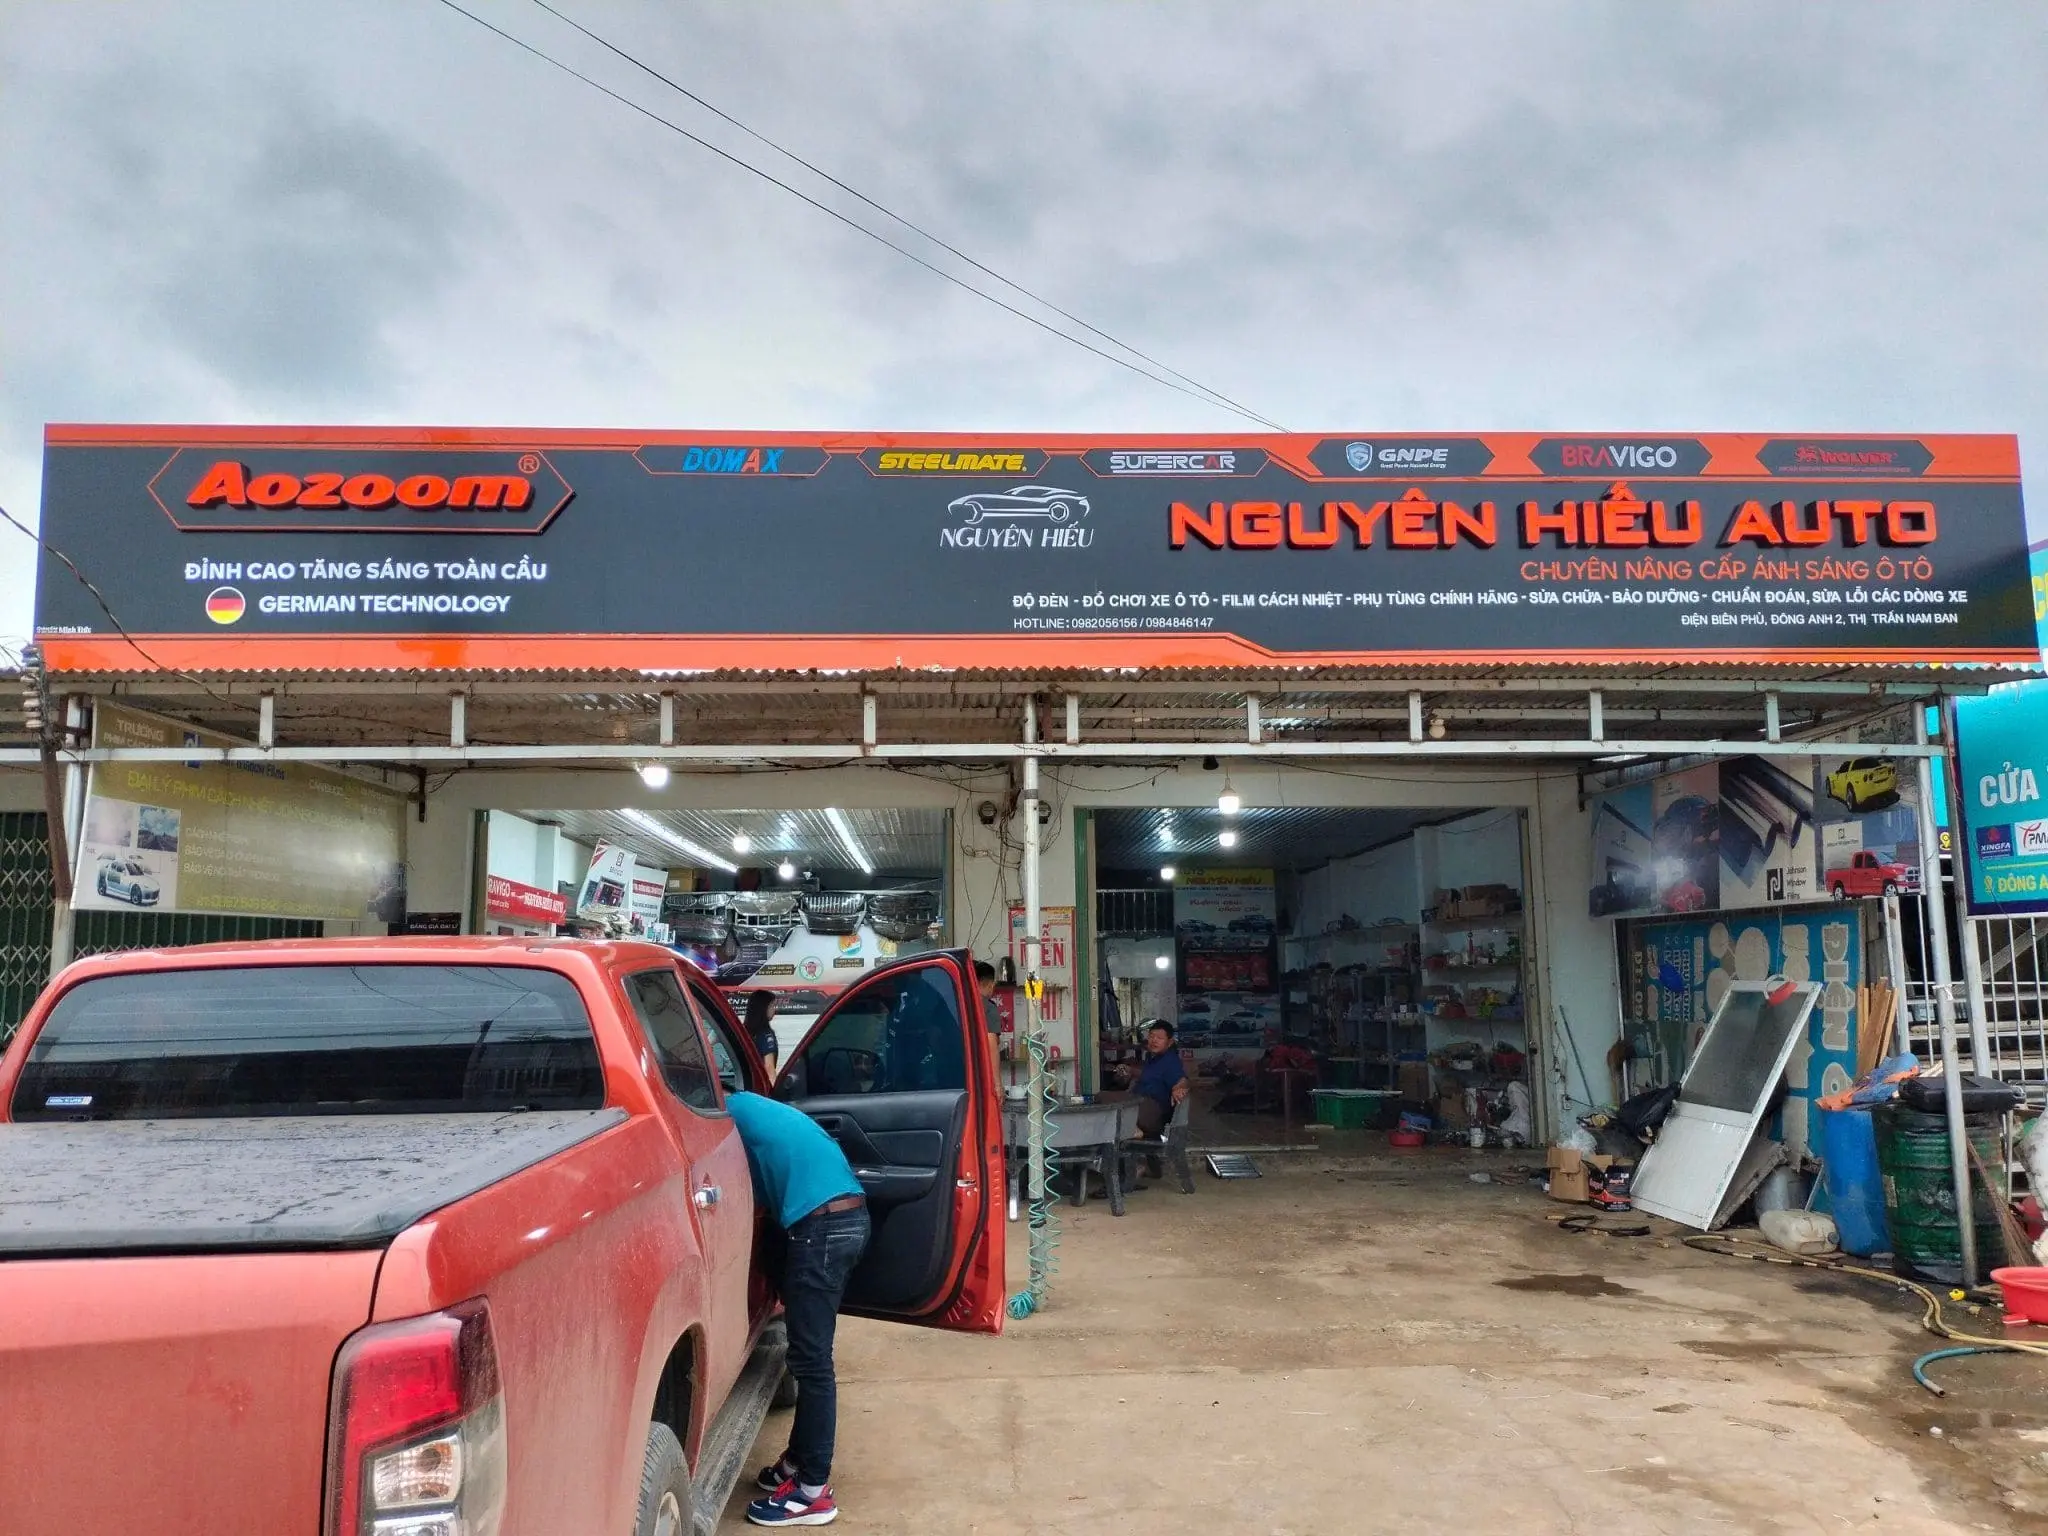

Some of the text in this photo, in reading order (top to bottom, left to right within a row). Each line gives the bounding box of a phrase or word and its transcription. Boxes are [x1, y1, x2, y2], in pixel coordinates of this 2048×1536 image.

[682, 448, 785, 474] DOMAX
[878, 452, 1026, 472] STEELMATE
[1110, 454, 1236, 469] SUPERCAR
[1378, 448, 1449, 462] GNPE
[1561, 445, 1678, 468] BRAVIGO
[185, 461, 532, 508] Aozoom
[939, 520, 1095, 548] NGUYÊN HIẾU
[1724, 500, 1938, 547] AUTO
[184, 553, 547, 581] ĐỈNH CAO TĂNG SÁNG TOÀN CẦU
[1519, 551, 1933, 581] CHUYÊN NÂNG CẤP ÁNH SÁNG Ô TÔ
[258, 594, 512, 613] GERMAN TECHNOLOGY
[1012, 592, 1035, 610] ĐỘ
[1038, 592, 1069, 608] ĐÈN
[1109, 594, 1147, 607] CHƠI
[1150, 594, 1171, 607] XE
[1174, 591, 1187, 607] Ô
[1188, 591, 1211, 607] TÔ
[1221, 594, 1256, 607] FILM
[1258, 591, 1299, 607] CÁCH
[1301, 591, 1344, 608] NHIỆT
[1353, 592, 1383, 608] PHỤ
[1386, 590, 1426, 606] TÙNG
[1429, 589, 1474, 605] CHÍNH
[1477, 589, 1519, 605] HÃNG
[1528, 588, 1560, 604] SỬA
[1561, 588, 1604, 604] CHỮA
[1612, 588, 1644, 604] BẢO
[1871, 587, 1901, 603] CÁC
[1903, 587, 1945, 603] DÒNG
[1948, 590, 1968, 603] XE
[1681, 612, 1709, 628] ĐIỆN
[1711, 611, 1738, 625] BIÊN
[1770, 612, 1805, 625] ĐÔNG
[1807, 613, 1833, 625] ANH
[1834, 613, 1846, 626] 2,
[1871, 610, 1904, 625] TRẤN
[1906, 613, 1932, 624] NAM
[1933, 613, 1958, 624] BAN
[1979, 761, 2040, 808] CỬA
[1980, 842, 2011, 851] XINGFA
[1997, 872, 2037, 894] ĐÔNG
